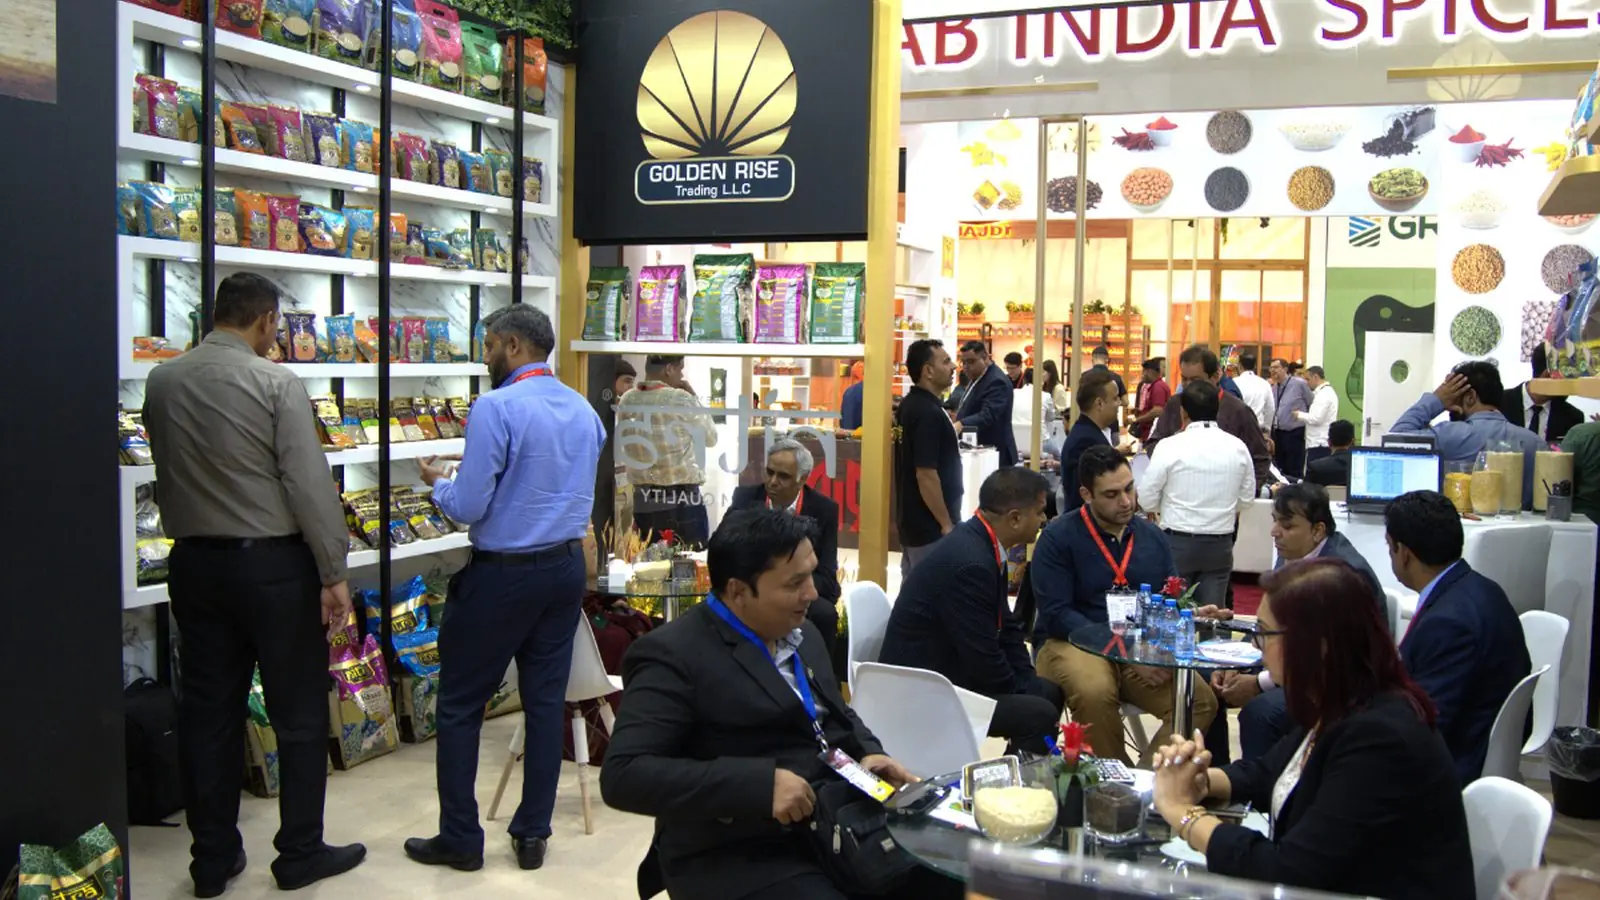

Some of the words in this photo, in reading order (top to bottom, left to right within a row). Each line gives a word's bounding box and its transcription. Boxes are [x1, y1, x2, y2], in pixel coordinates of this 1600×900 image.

[1015, 0, 1276, 60] INDIA
[650, 163, 726, 182] GOLDEN
[735, 161, 779, 179] RISE
[675, 184, 718, 198] Trading
